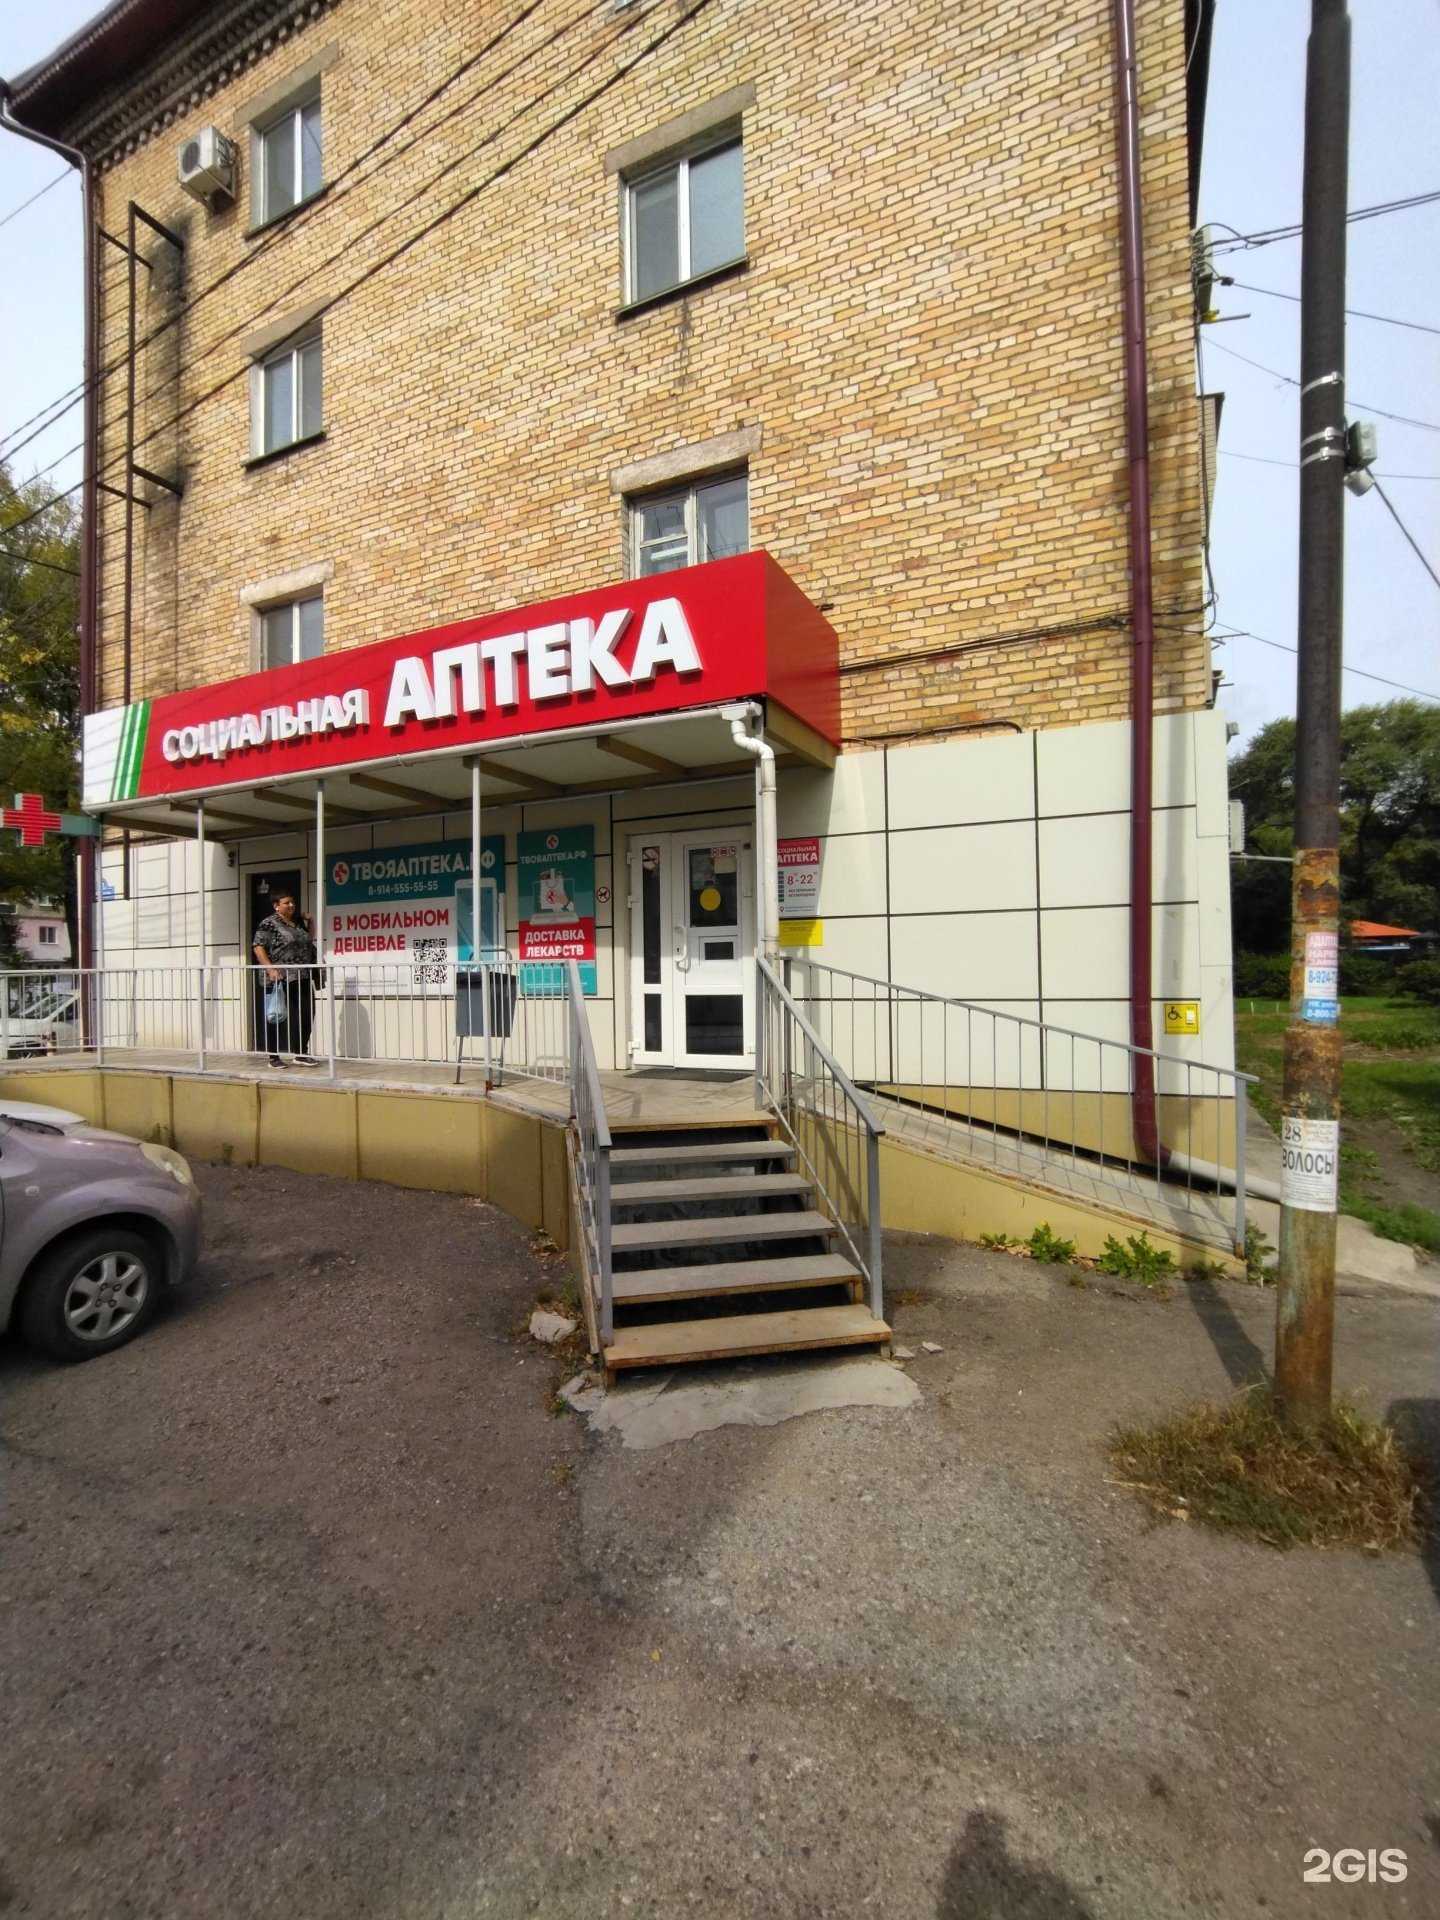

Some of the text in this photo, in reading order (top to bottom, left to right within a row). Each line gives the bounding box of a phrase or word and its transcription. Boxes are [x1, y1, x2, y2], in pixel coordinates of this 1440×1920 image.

[162, 597, 703, 763] СОЦИАЛЬНАЯ АПТЕКА
[352, 850, 495, 881] ТВОЯАПТЕКА.Ф
[333, 908, 449, 932] В МОБИЛЬНОМ
[333, 934, 406, 956] ДЕШЕВЛЕ
[525, 928, 586, 945] ДОСТАВКА
[526, 944, 585, 958] ЛЕКАРСТВ
[1282, 1147, 1336, 1175] ВОЛОСЫ
